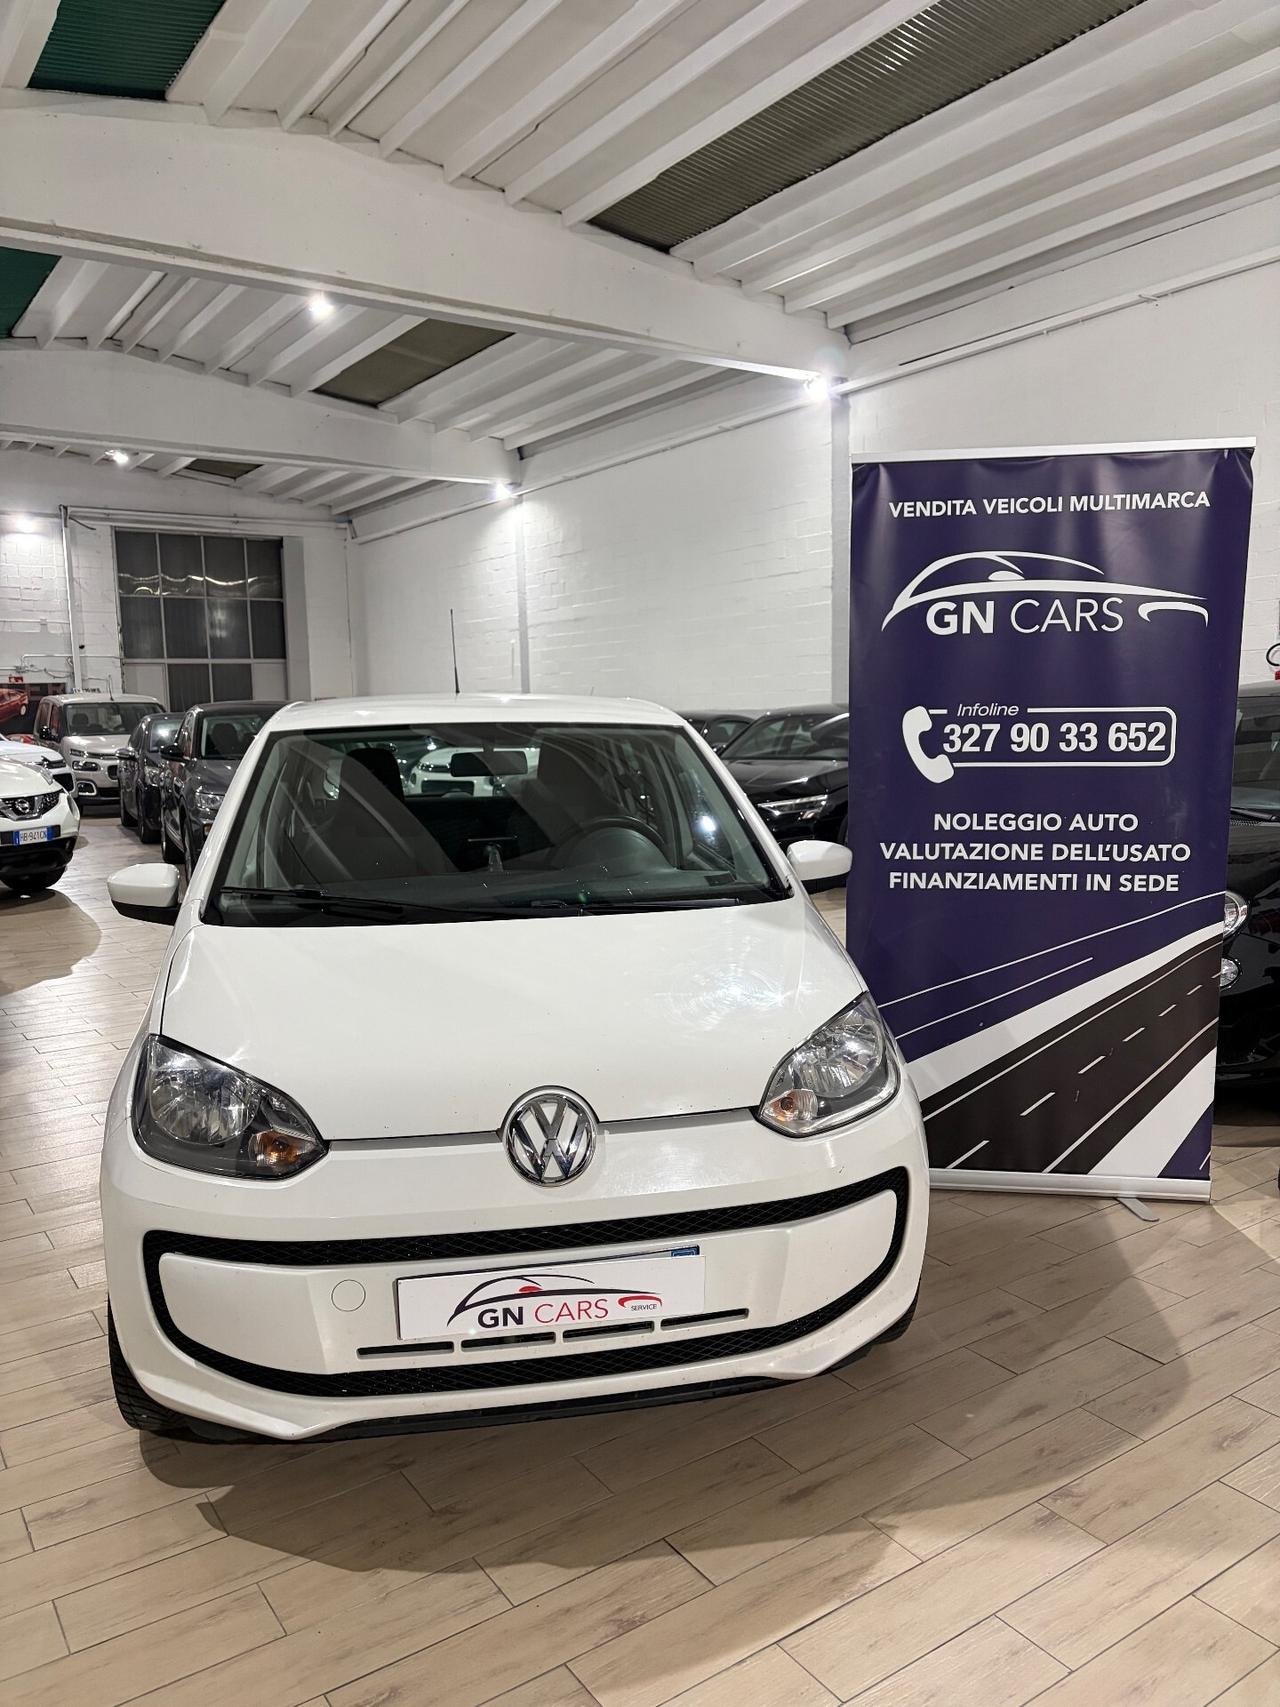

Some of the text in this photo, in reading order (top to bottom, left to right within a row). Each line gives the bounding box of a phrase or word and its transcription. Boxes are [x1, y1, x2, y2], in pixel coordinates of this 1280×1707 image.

[889, 491, 1211, 518] VENDITA VEICOLI MULTIMARCA
[926, 597, 1124, 636] GN CARS
[957, 702, 1020, 718] Infoline
[943, 722, 1166, 753] 327 90 33 652
[934, 813, 1139, 832] NOLEGGIO AUTO
[880, 842, 1191, 862] VALUTAZIONE DELL'USATO
[889, 871, 1179, 892] FINANZIAMENTI IN SEDE
[477, 1299, 609, 1329] GN CARS
[630, 1303, 658, 1311] SERVICE
